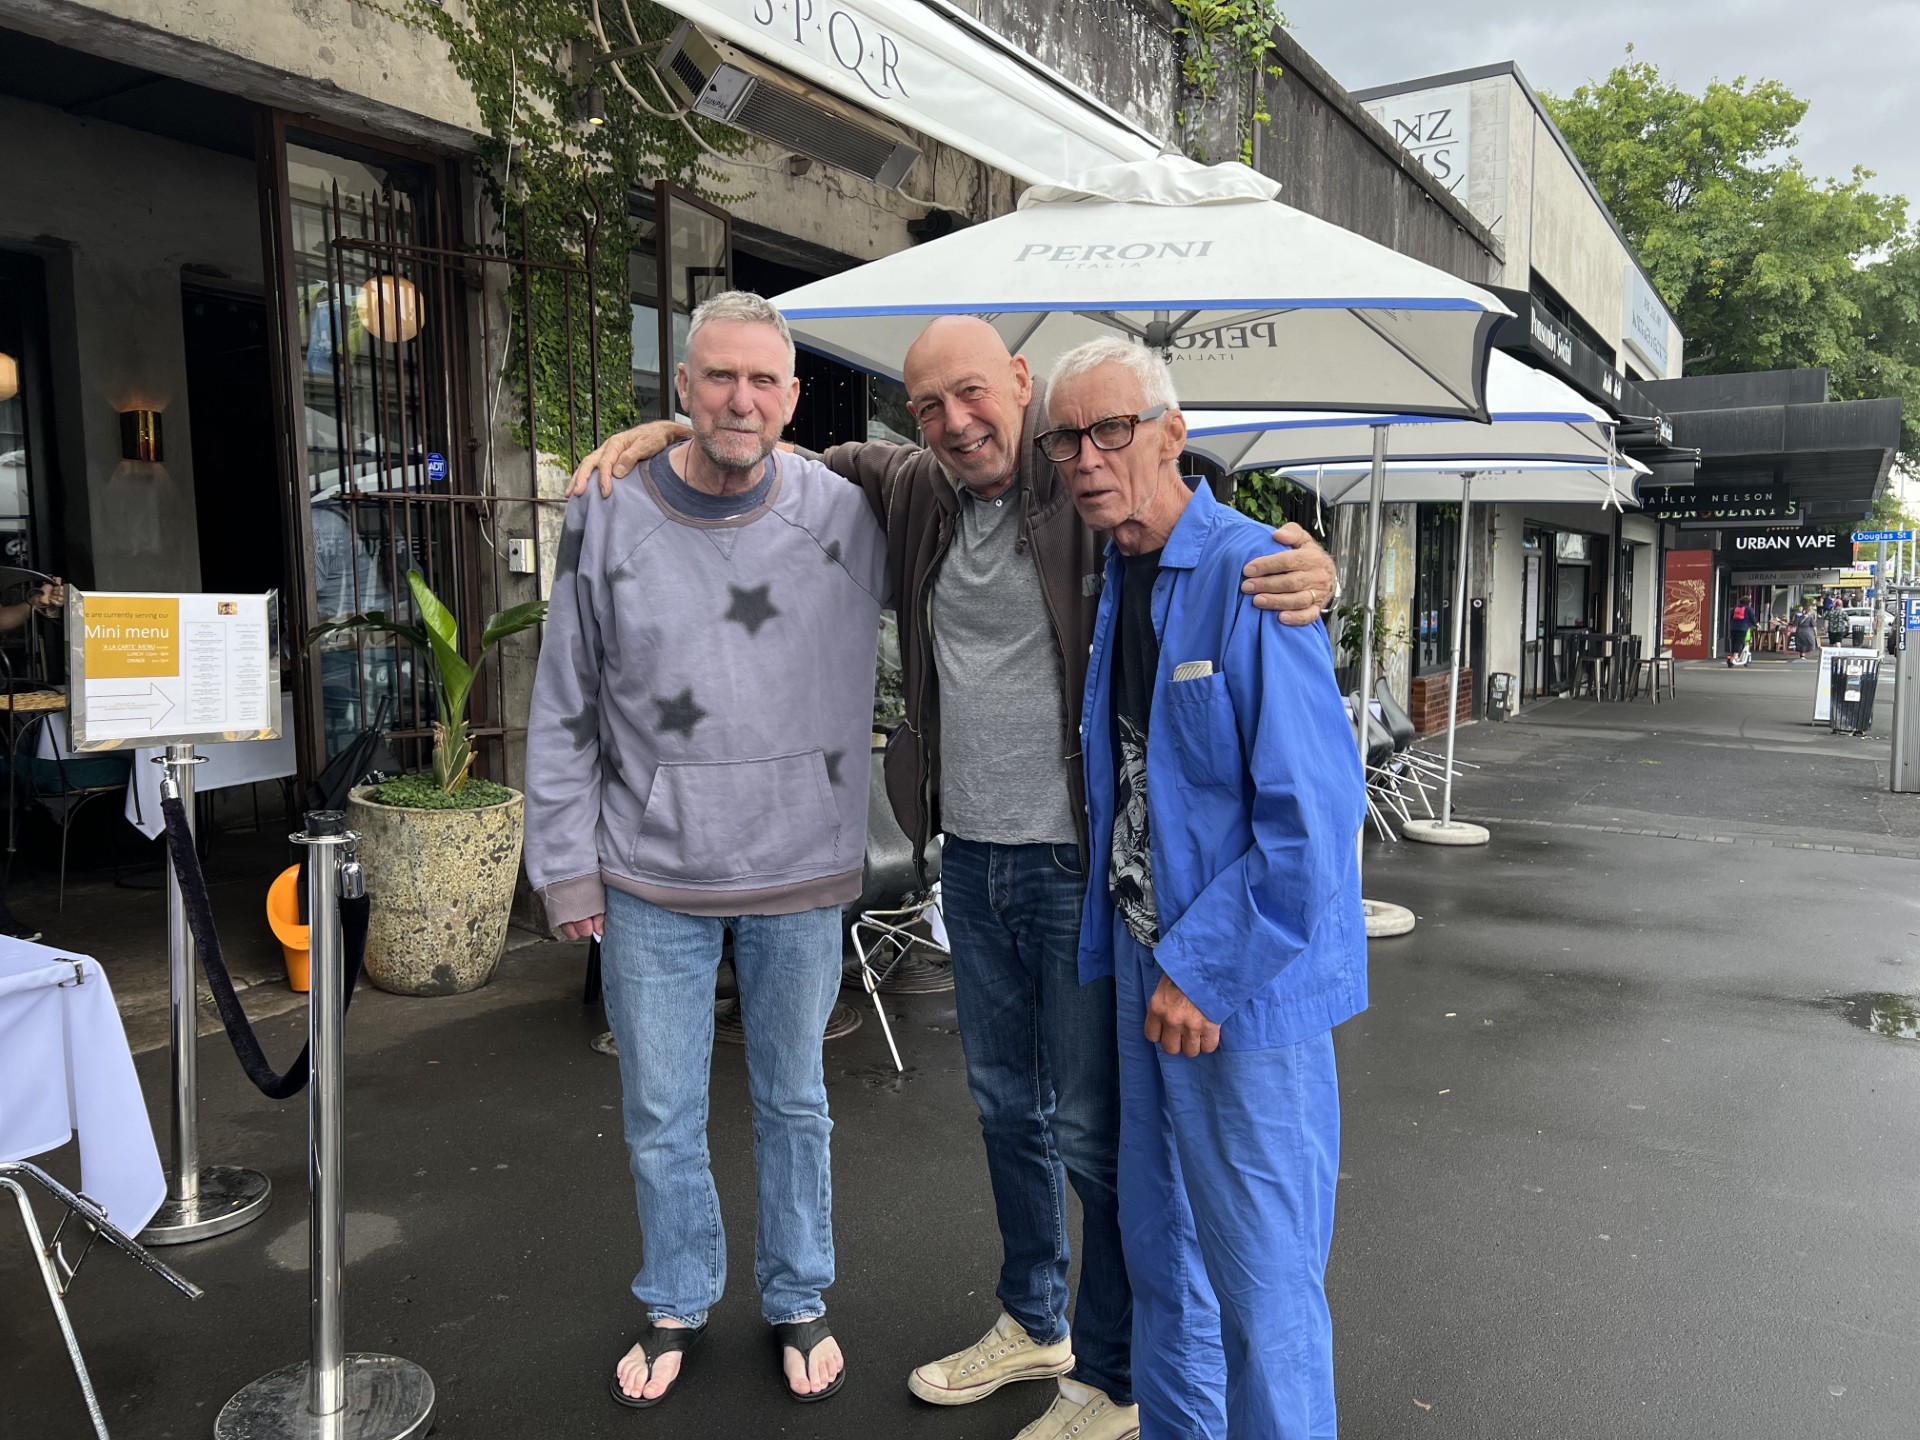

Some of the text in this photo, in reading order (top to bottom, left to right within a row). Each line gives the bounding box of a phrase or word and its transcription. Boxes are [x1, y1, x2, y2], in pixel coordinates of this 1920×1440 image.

[1013, 240, 1216, 262] PERONI
[1064, 261, 1142, 270] ITALIA
[428, 461, 444, 472] ADT
[1712, 493, 1773, 502] NELSON
[1857, 531, 1907, 541] Douglas St
[1736, 534, 1836, 550] URBAN VAPE
[103, 611, 134, 619] currently
[134, 612, 158, 620] serving
[85, 624, 169, 639] Mini menu
